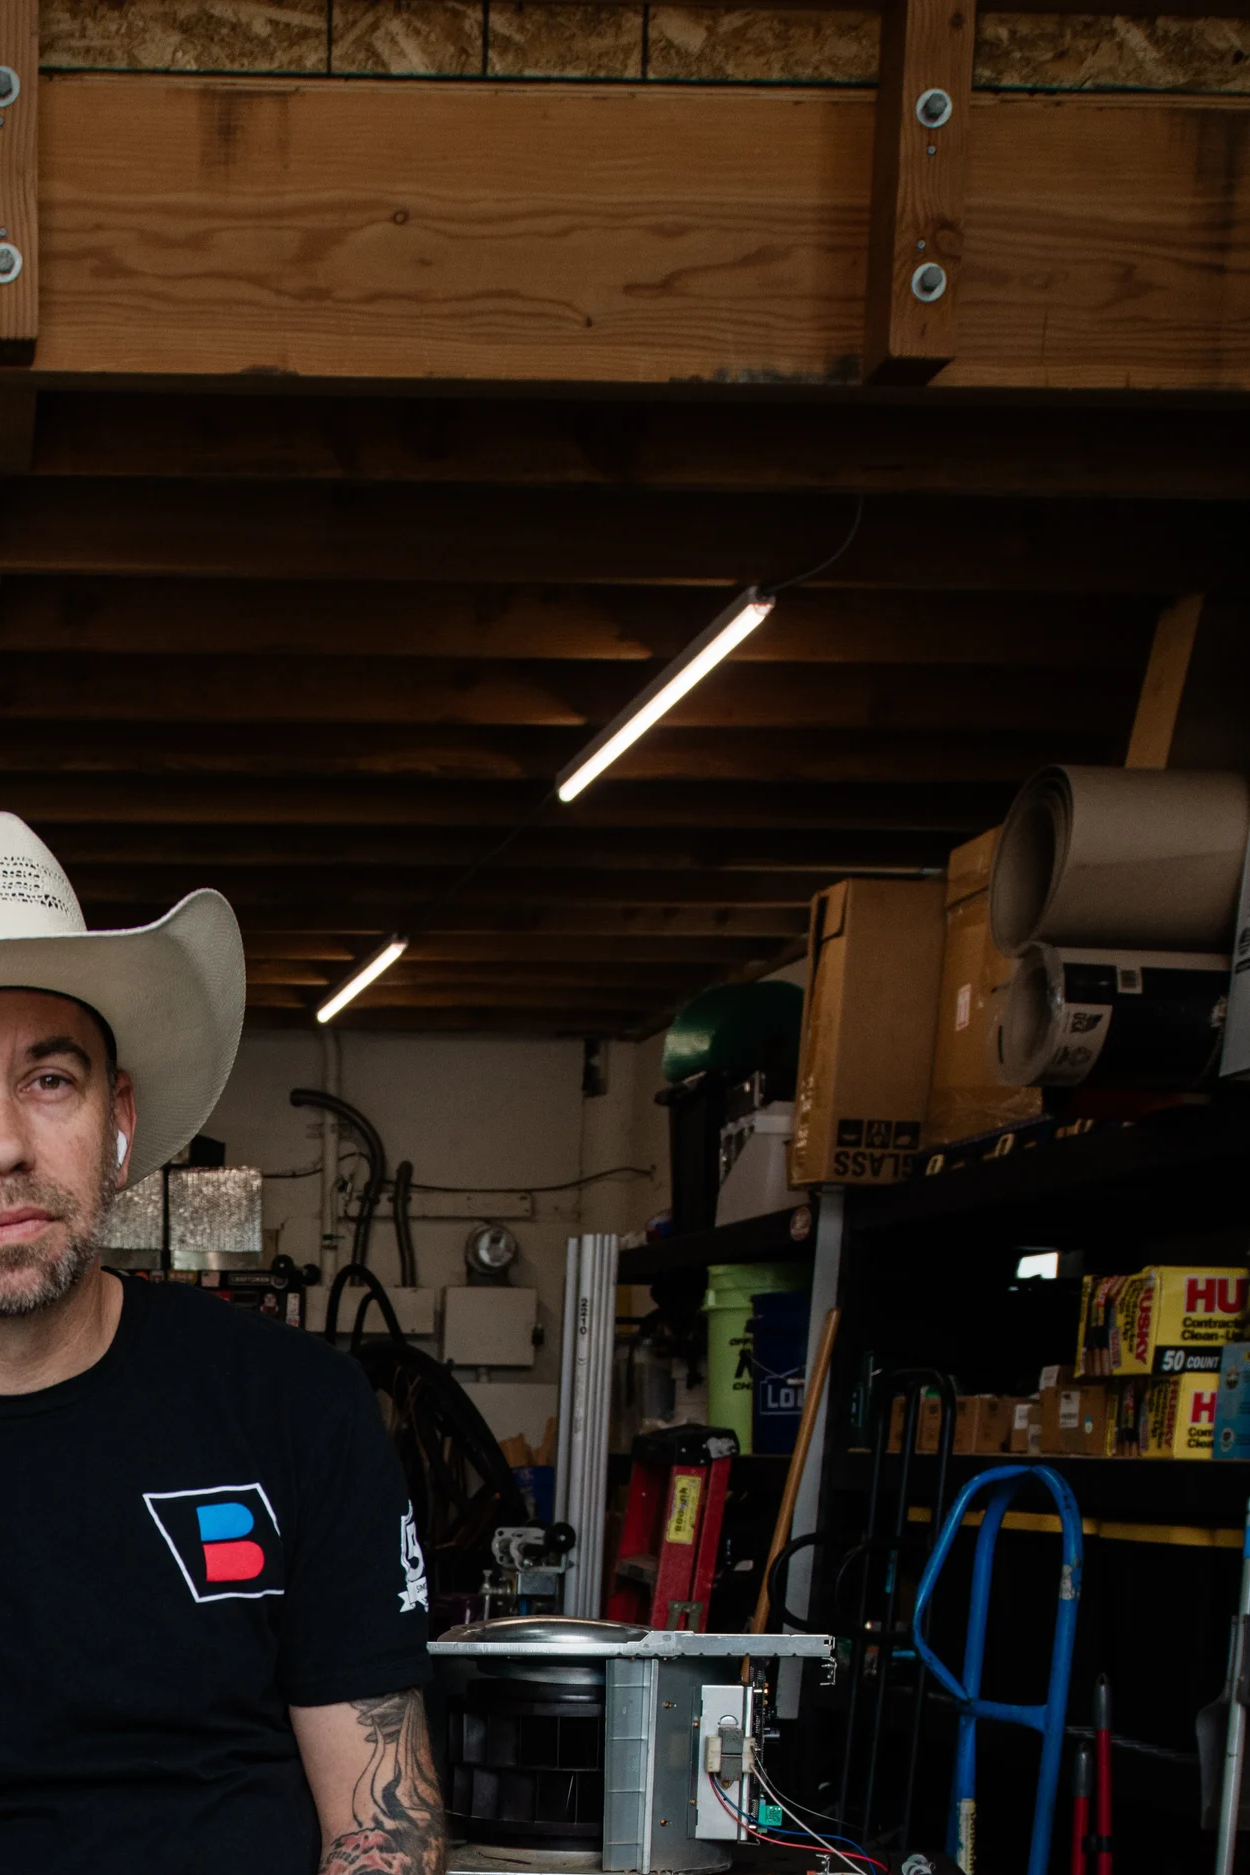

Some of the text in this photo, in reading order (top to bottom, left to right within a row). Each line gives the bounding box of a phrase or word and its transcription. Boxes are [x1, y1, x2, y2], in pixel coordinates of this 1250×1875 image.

[833, 1151, 914, 1178] GLASS
[1161, 1350, 1221, 1371] 50 COUNT
